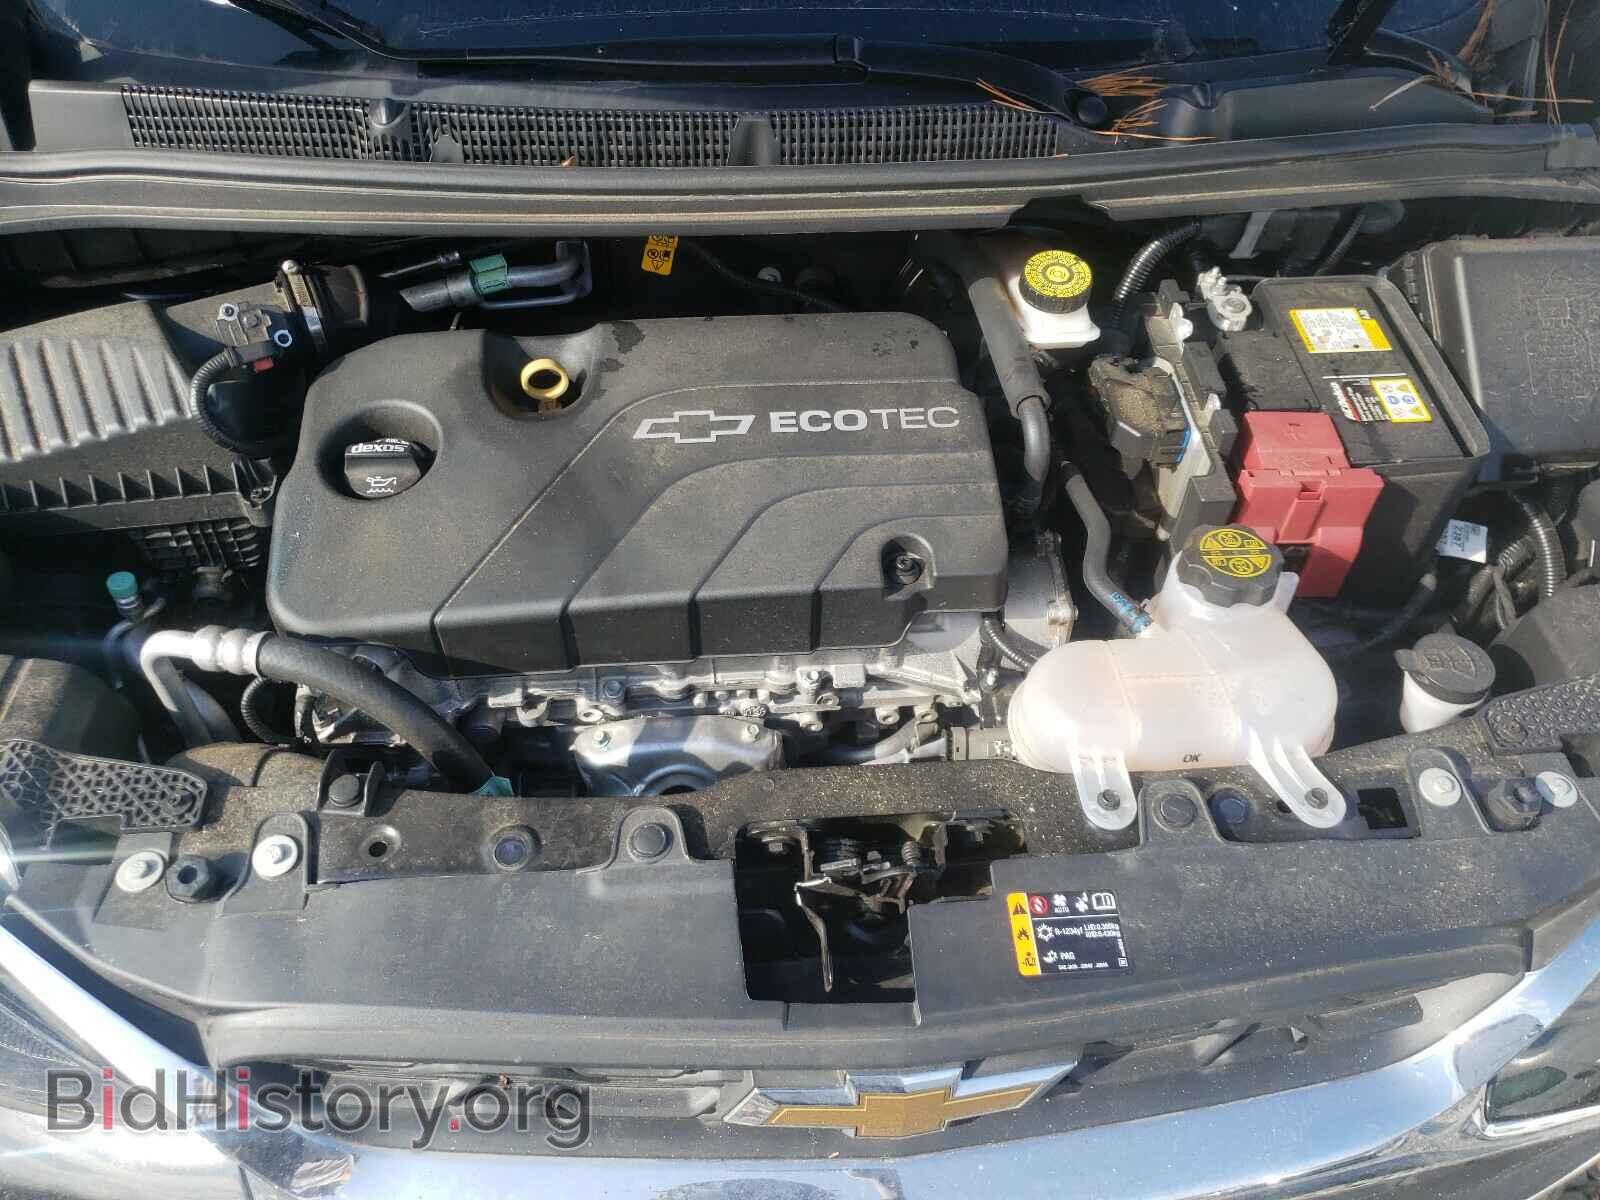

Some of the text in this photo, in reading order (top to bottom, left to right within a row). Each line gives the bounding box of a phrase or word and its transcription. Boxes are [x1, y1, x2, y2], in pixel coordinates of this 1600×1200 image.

[769, 407, 959, 433] ECOTEC
[351, 442, 408, 453] dexos
[1183, 753, 1201, 763] OK
